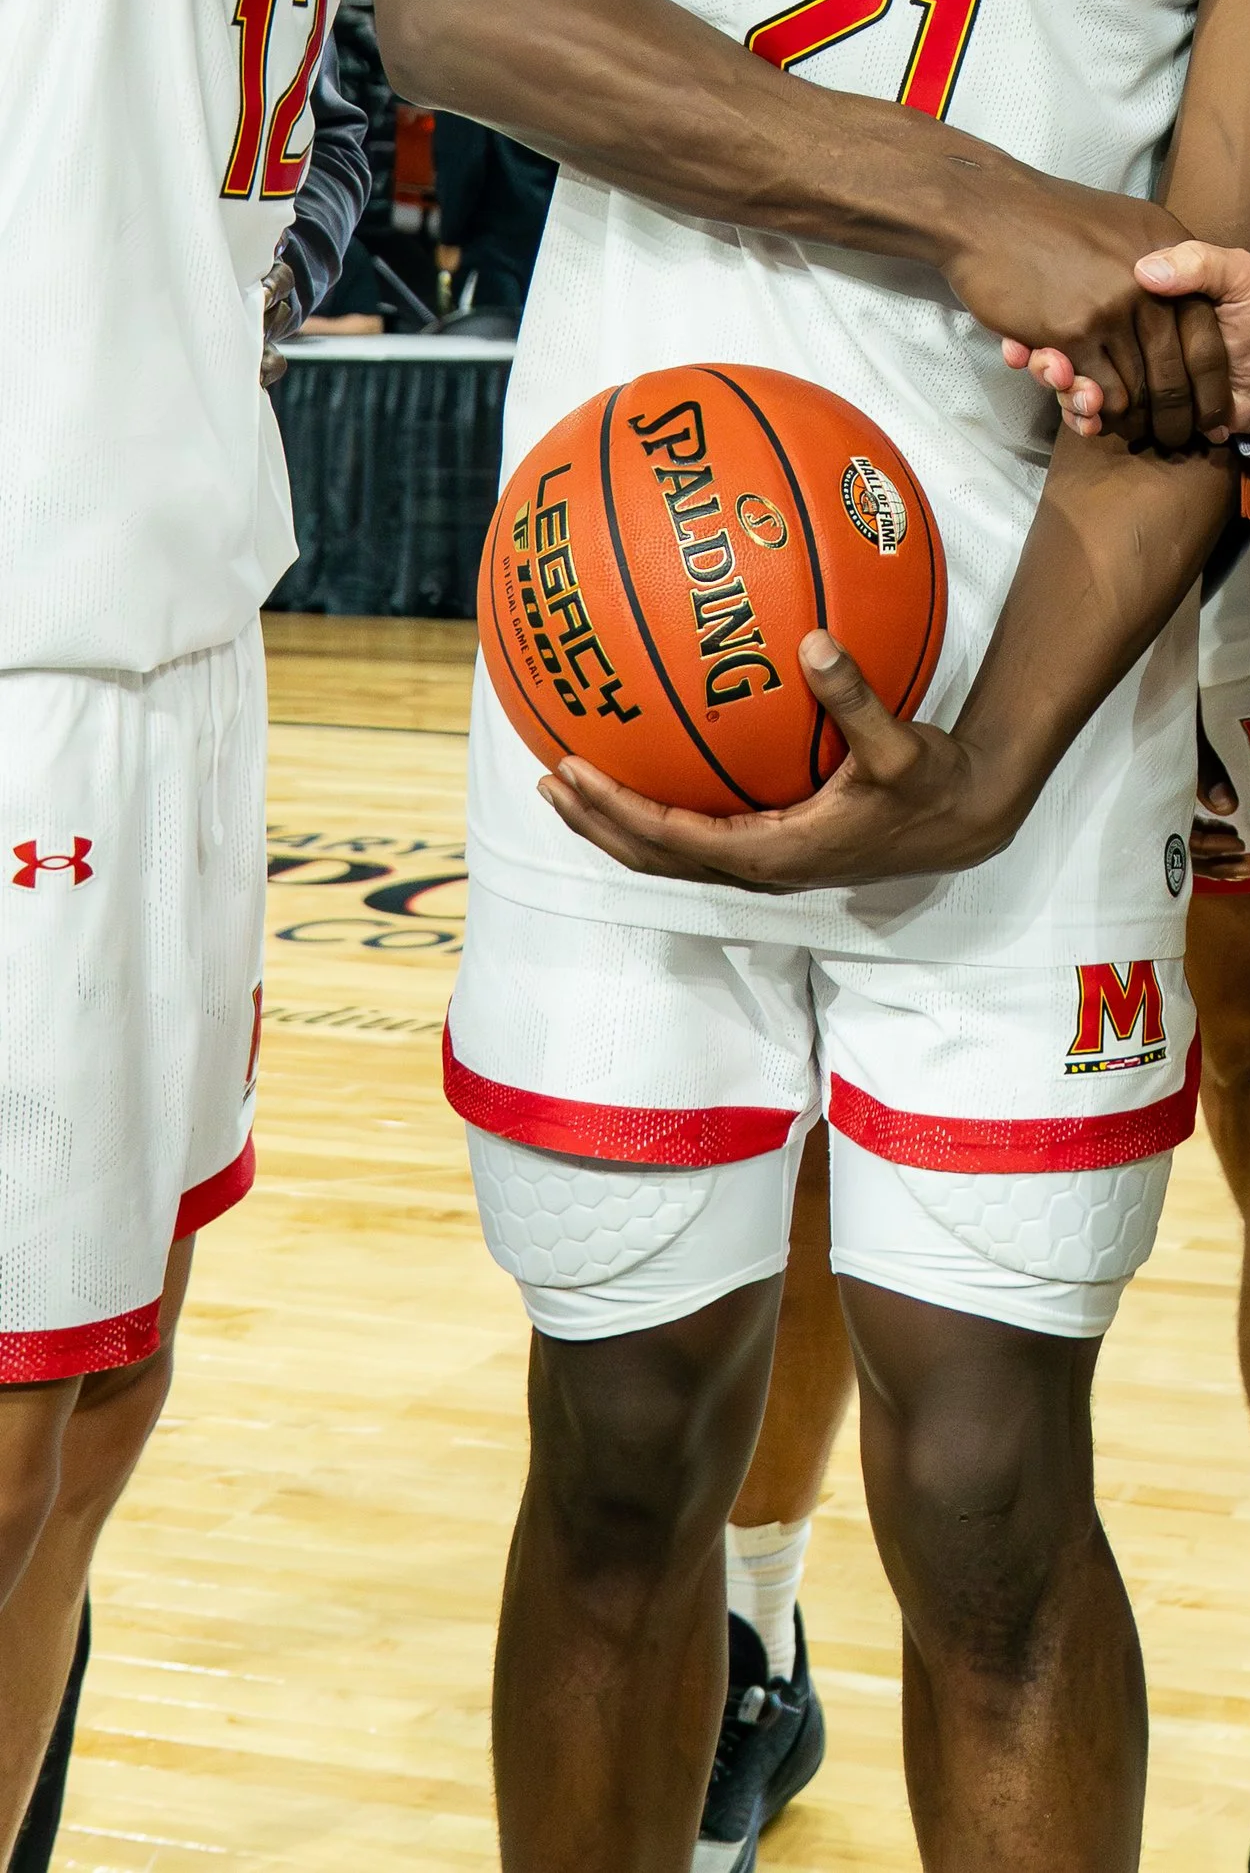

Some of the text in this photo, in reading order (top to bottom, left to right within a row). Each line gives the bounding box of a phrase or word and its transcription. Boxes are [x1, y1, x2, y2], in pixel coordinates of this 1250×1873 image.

[855, 458, 882, 493] HALL
[877, 493, 890, 508] OF
[879, 511, 896, 551] FAME
[535, 462, 643, 724] LEGACY
[627, 400, 784, 708] SPALDING
[502, 556, 544, 690] OFFICIAL GAME BALL
[516, 558, 587, 716] 1000
